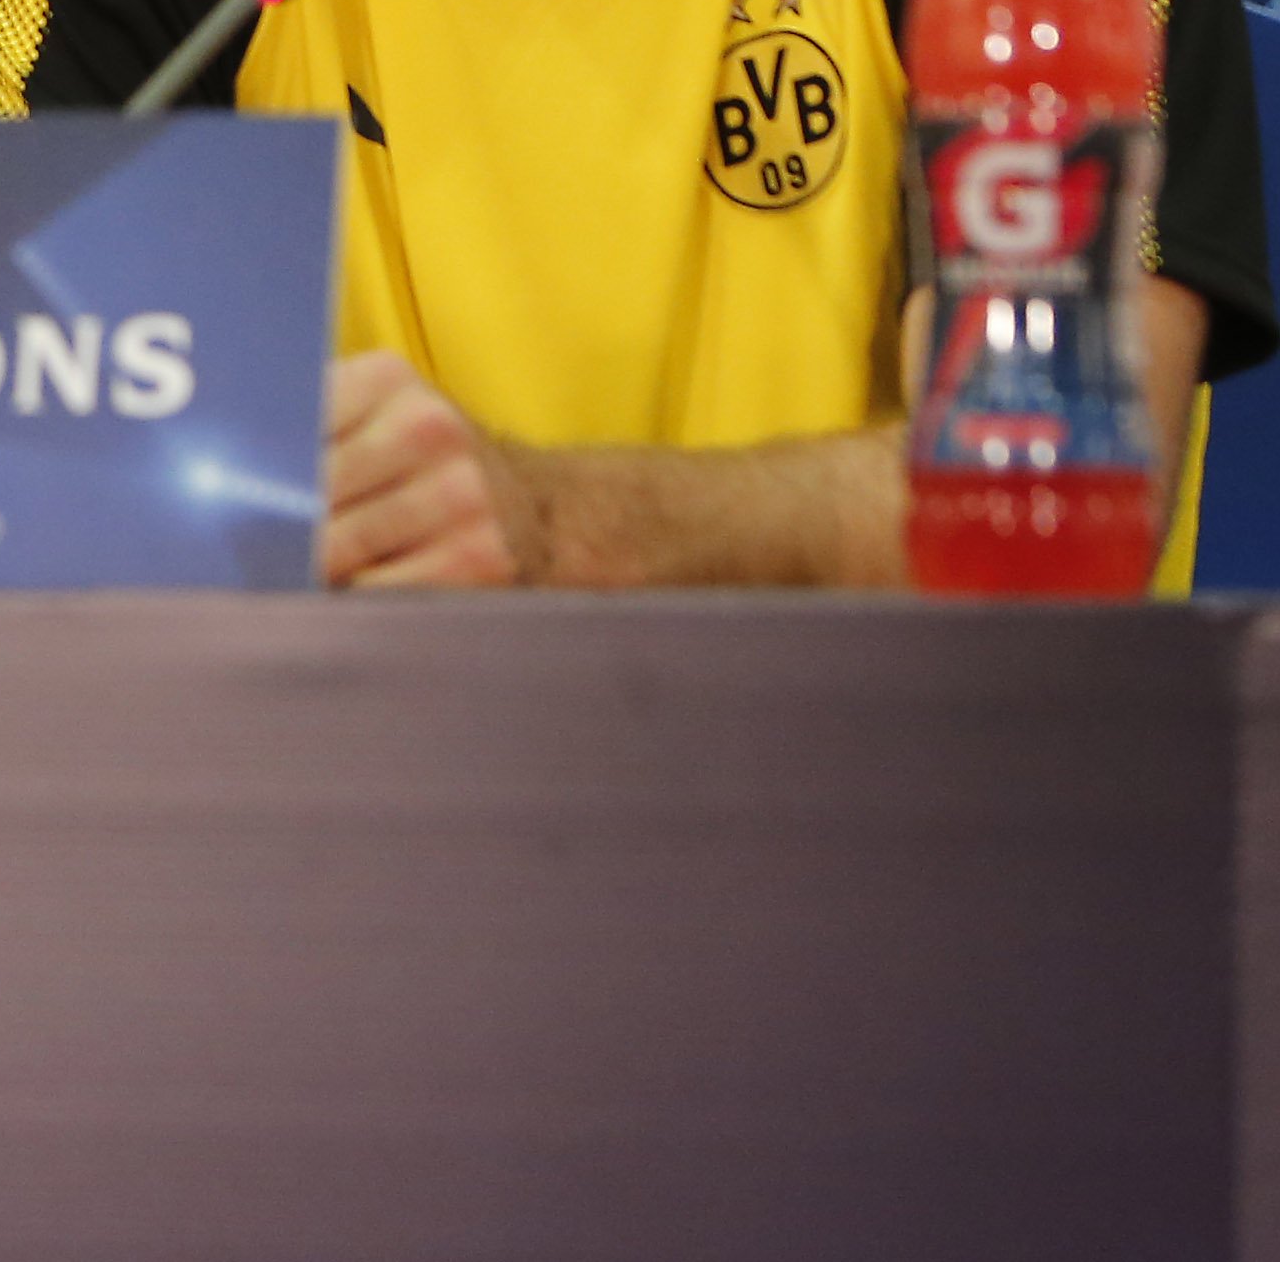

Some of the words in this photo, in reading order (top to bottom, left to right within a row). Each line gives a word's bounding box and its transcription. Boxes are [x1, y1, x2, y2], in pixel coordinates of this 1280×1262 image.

[714, 47, 836, 168] BVB
[762, 154, 808, 196] 09
[955, 139, 1064, 253] G
